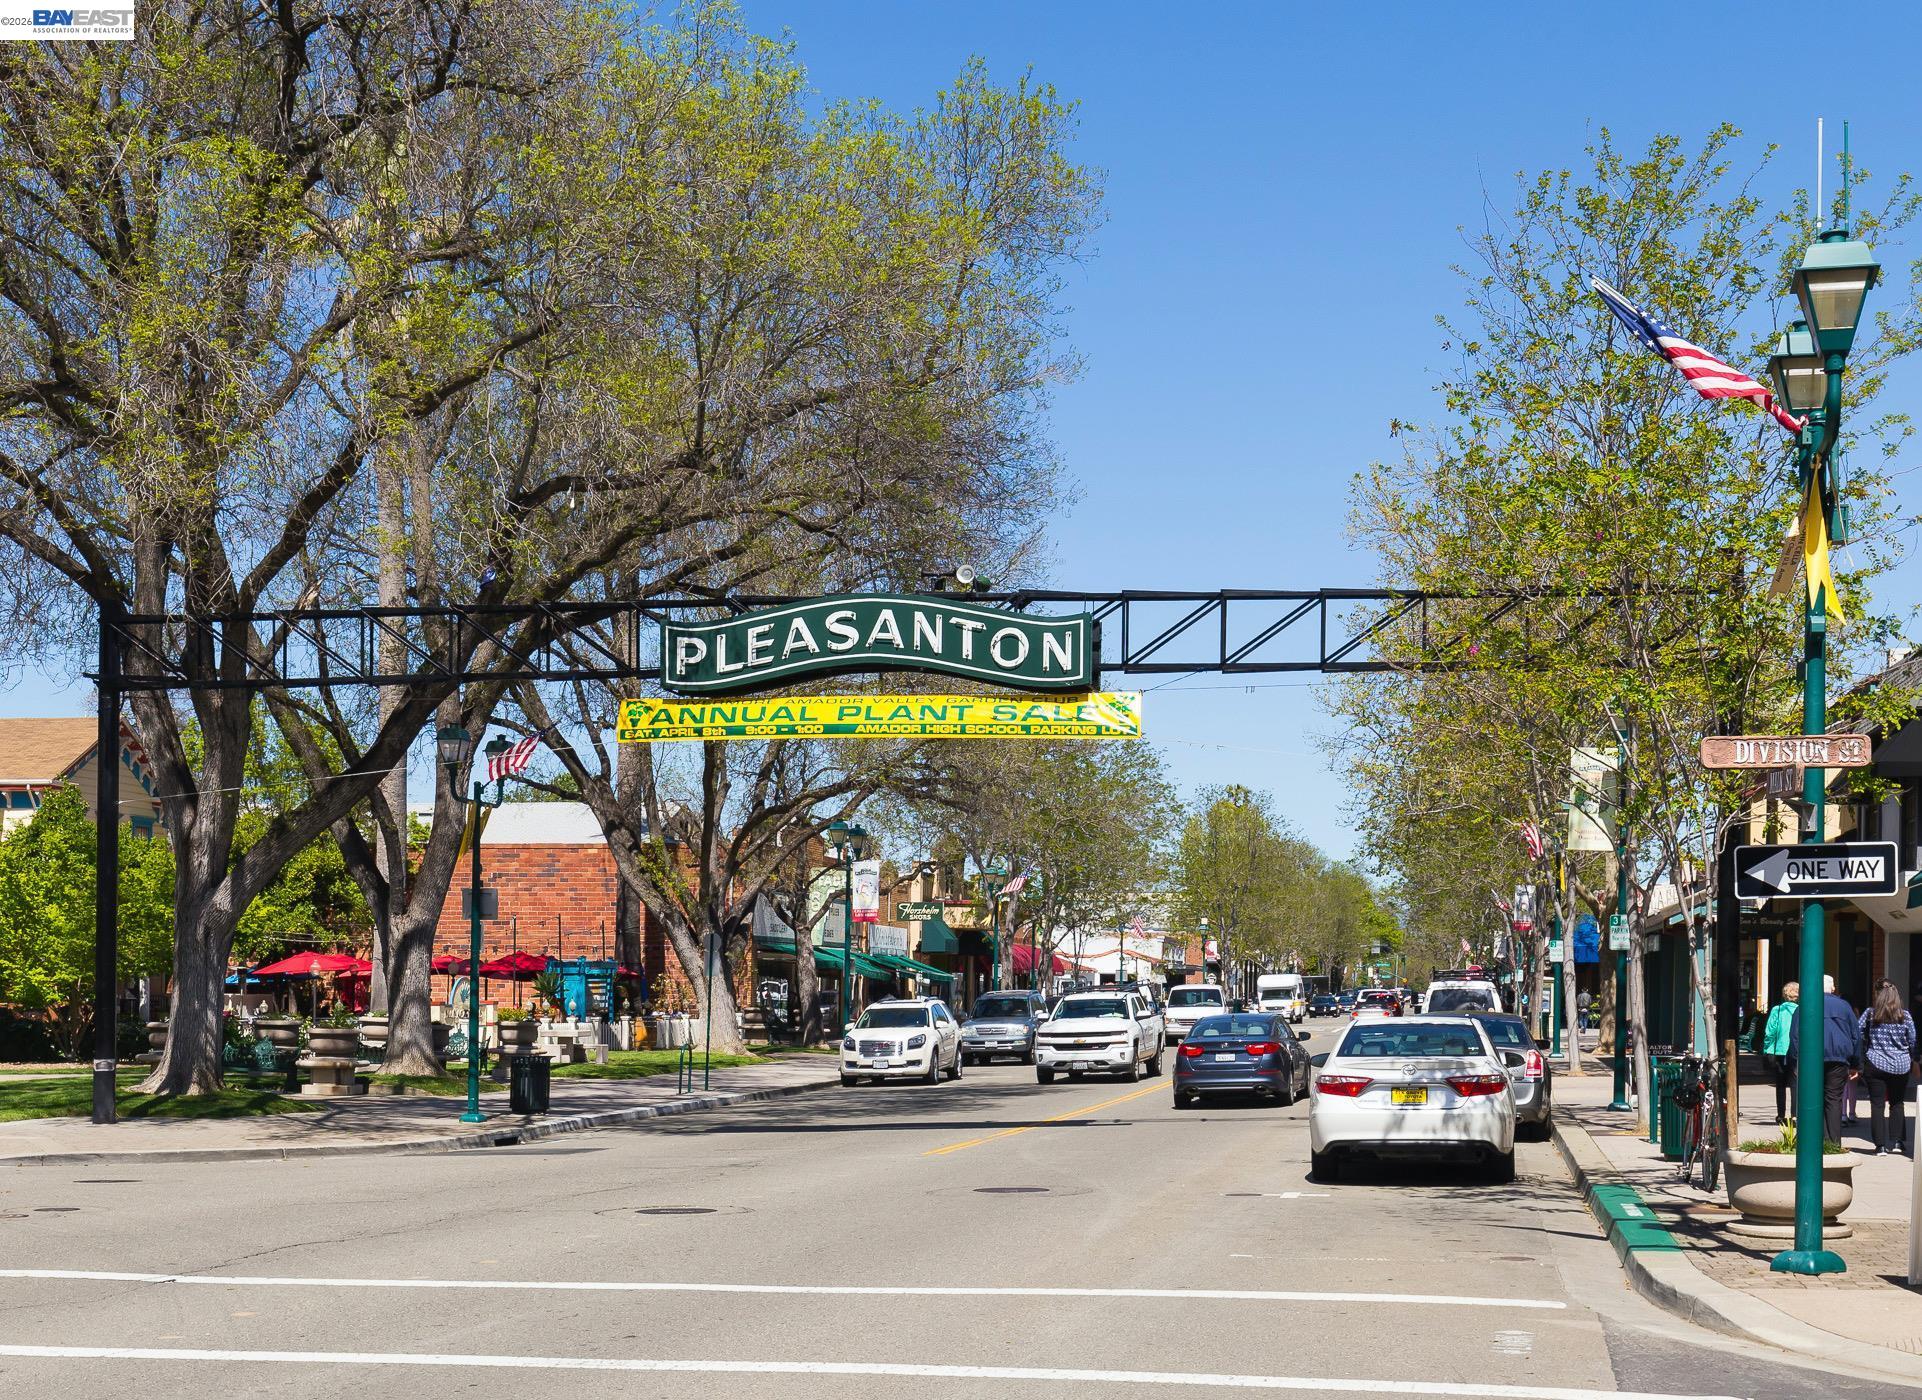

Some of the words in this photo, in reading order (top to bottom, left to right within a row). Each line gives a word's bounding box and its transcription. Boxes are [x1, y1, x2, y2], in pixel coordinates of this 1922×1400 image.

[676, 609, 1073, 676] PLEASANTON
[1031, 696, 1079, 704] CLUB
[649, 705, 818, 725] ANNUAL
[837, 705, 973, 721] PLANT
[993, 704, 1099, 722] SALE
[624, 727, 655, 739] SAT.
[659, 727, 699, 738] APRIL
[702, 727, 727, 736] 8th
[745, 725, 777, 735] 9:00
[795, 725, 824, 735] 1:00
[855, 724, 922, 734] AMADOR
[926, 724, 961, 734] HIGH
[965, 724, 1026, 735] SCHOOL
[1031, 725, 1097, 735] PARKING
[1733, 739, 1830, 764] DIVISION
[1769, 771, 1784, 794] MAIN
[1785, 769, 1793, 792] ST
[1786, 860, 1829, 881] ONE
[1839, 859, 1881, 880] WAY
[1613, 916, 1619, 925] 3
